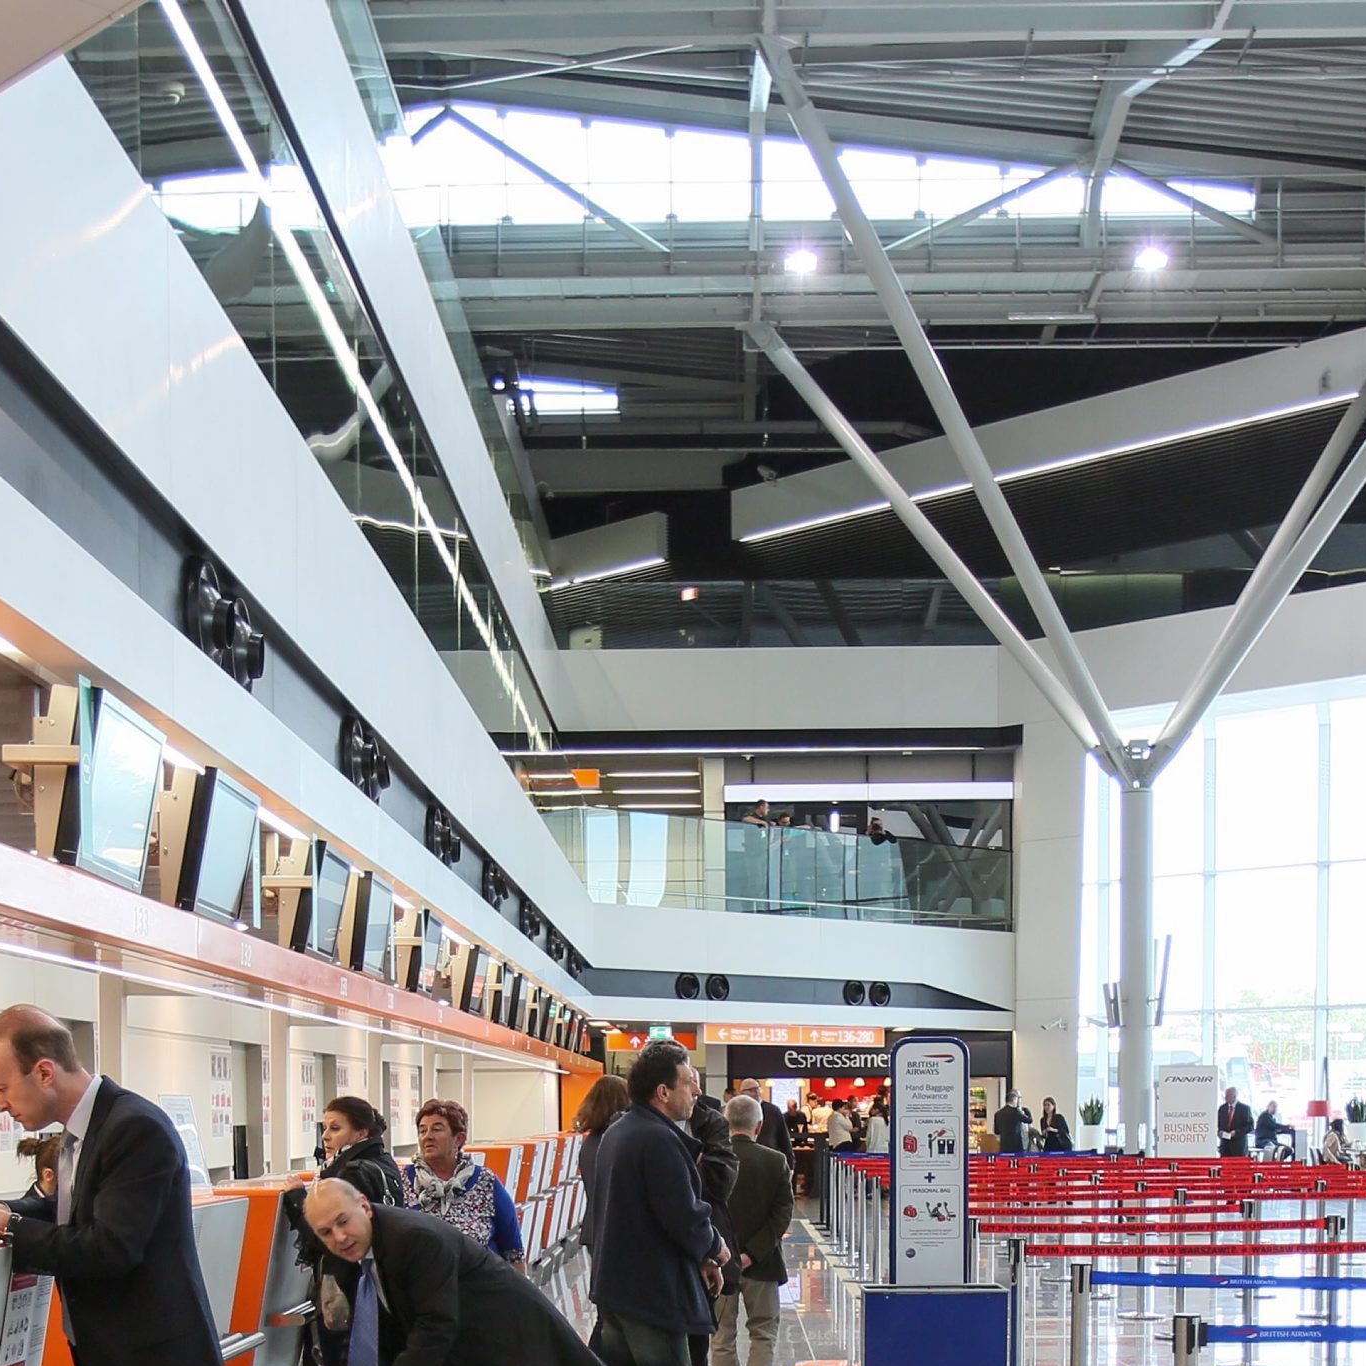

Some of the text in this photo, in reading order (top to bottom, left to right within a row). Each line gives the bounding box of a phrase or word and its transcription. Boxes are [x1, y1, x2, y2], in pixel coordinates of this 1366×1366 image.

[785, 1050, 890, 1068] espressame
[926, 1084, 954, 1092] Baggage
[1164, 1123, 1210, 1132] BUSINESS
[1164, 1134, 1208, 1143] PRIORITY
